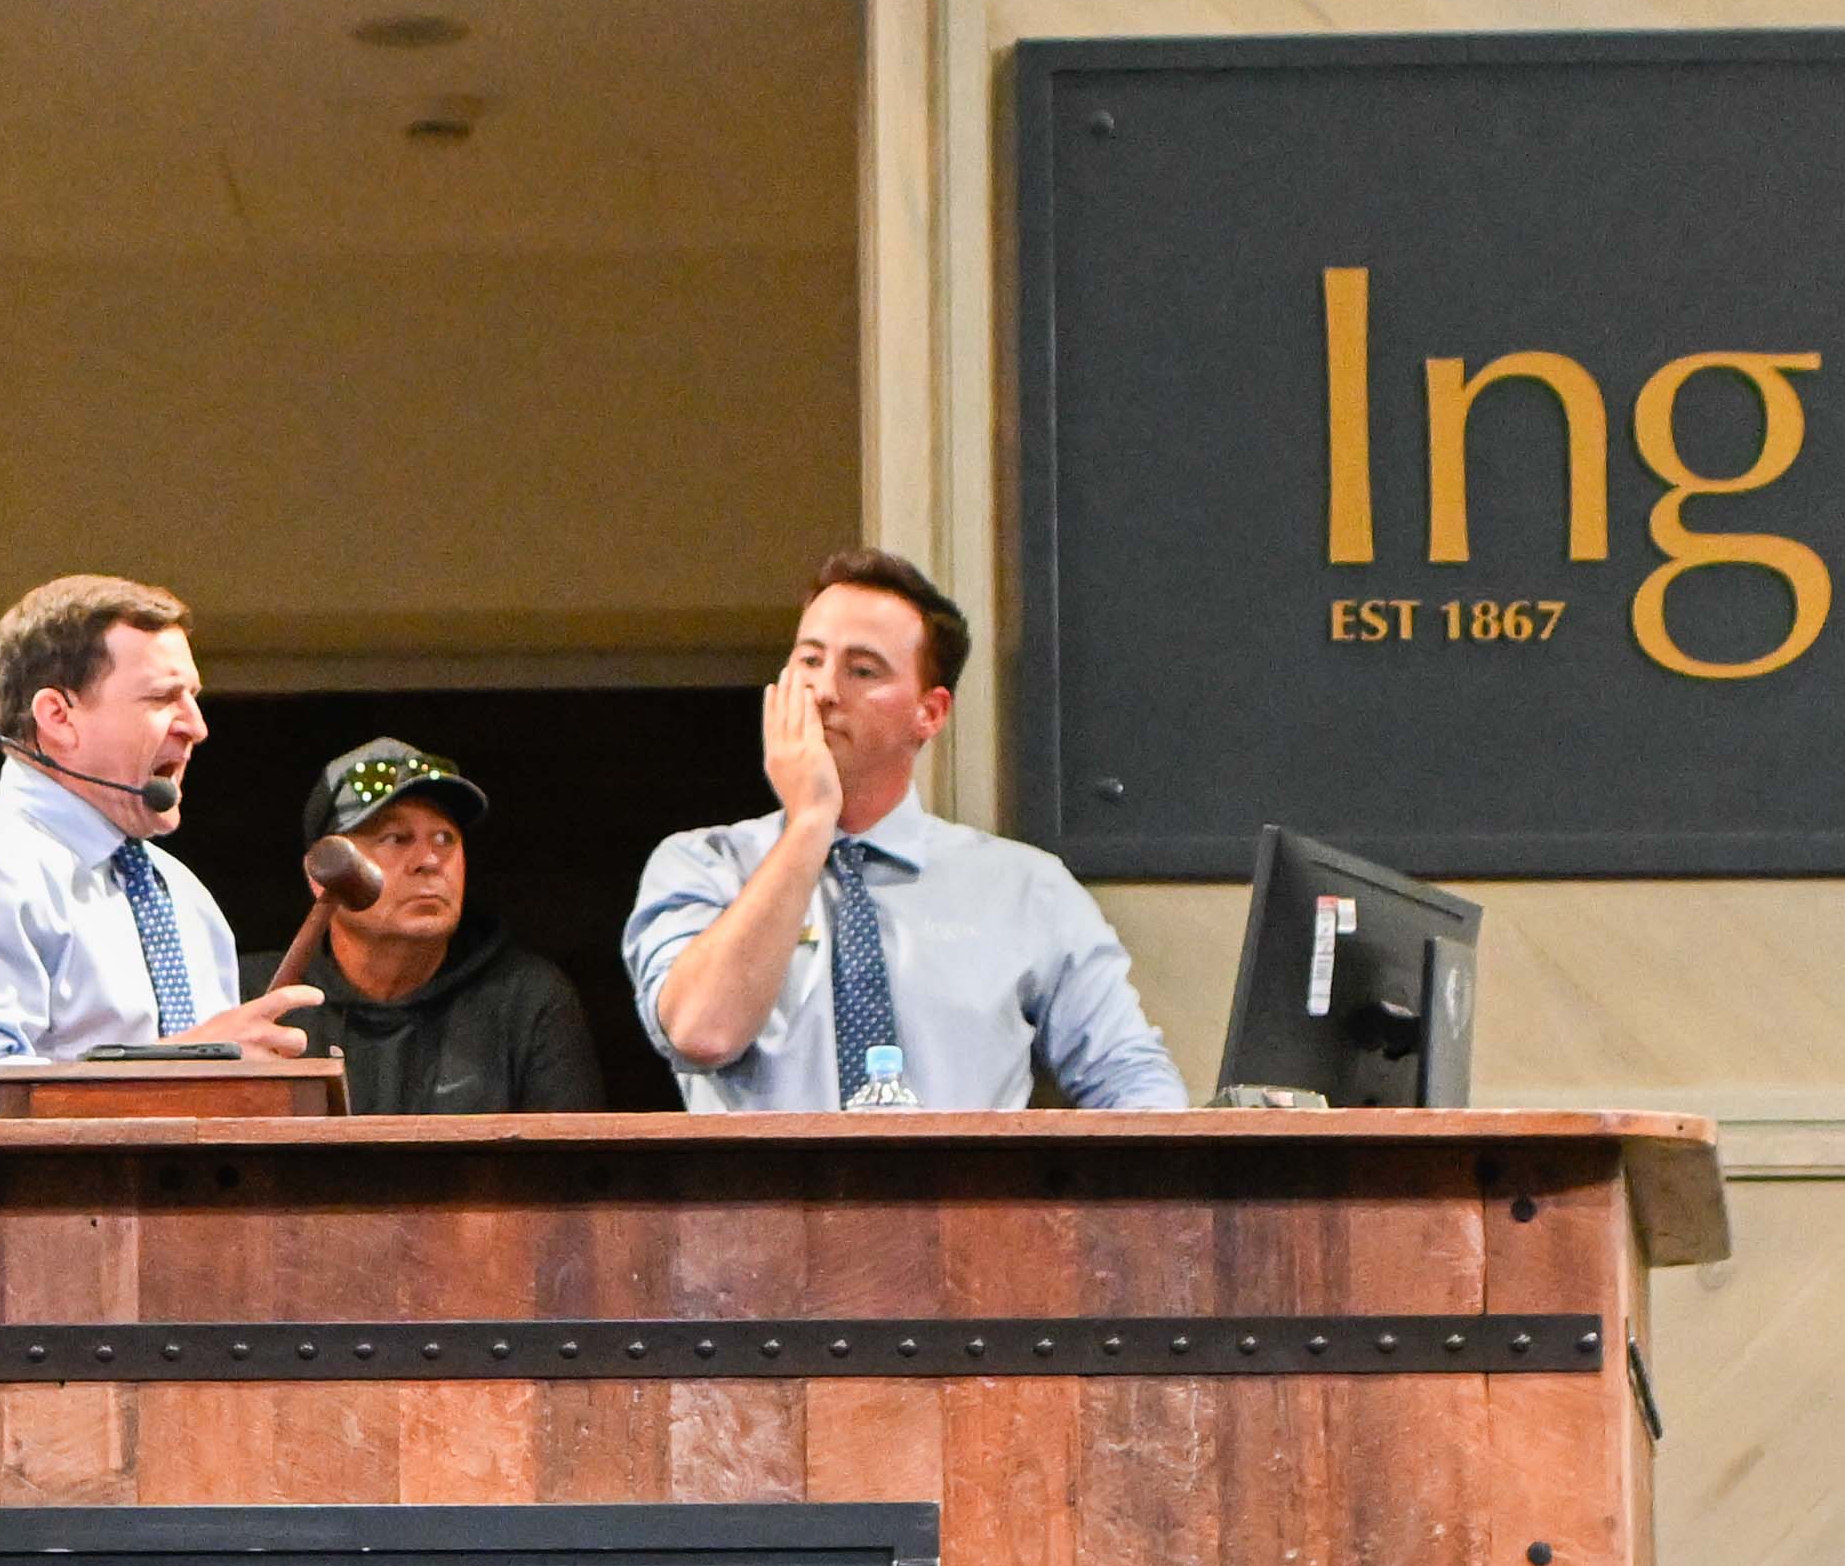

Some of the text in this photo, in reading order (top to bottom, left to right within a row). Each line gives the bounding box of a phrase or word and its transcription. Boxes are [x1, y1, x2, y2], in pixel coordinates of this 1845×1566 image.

[1323, 266, 1835, 680] Ing
[1329, 598, 1569, 642] EST 1867
